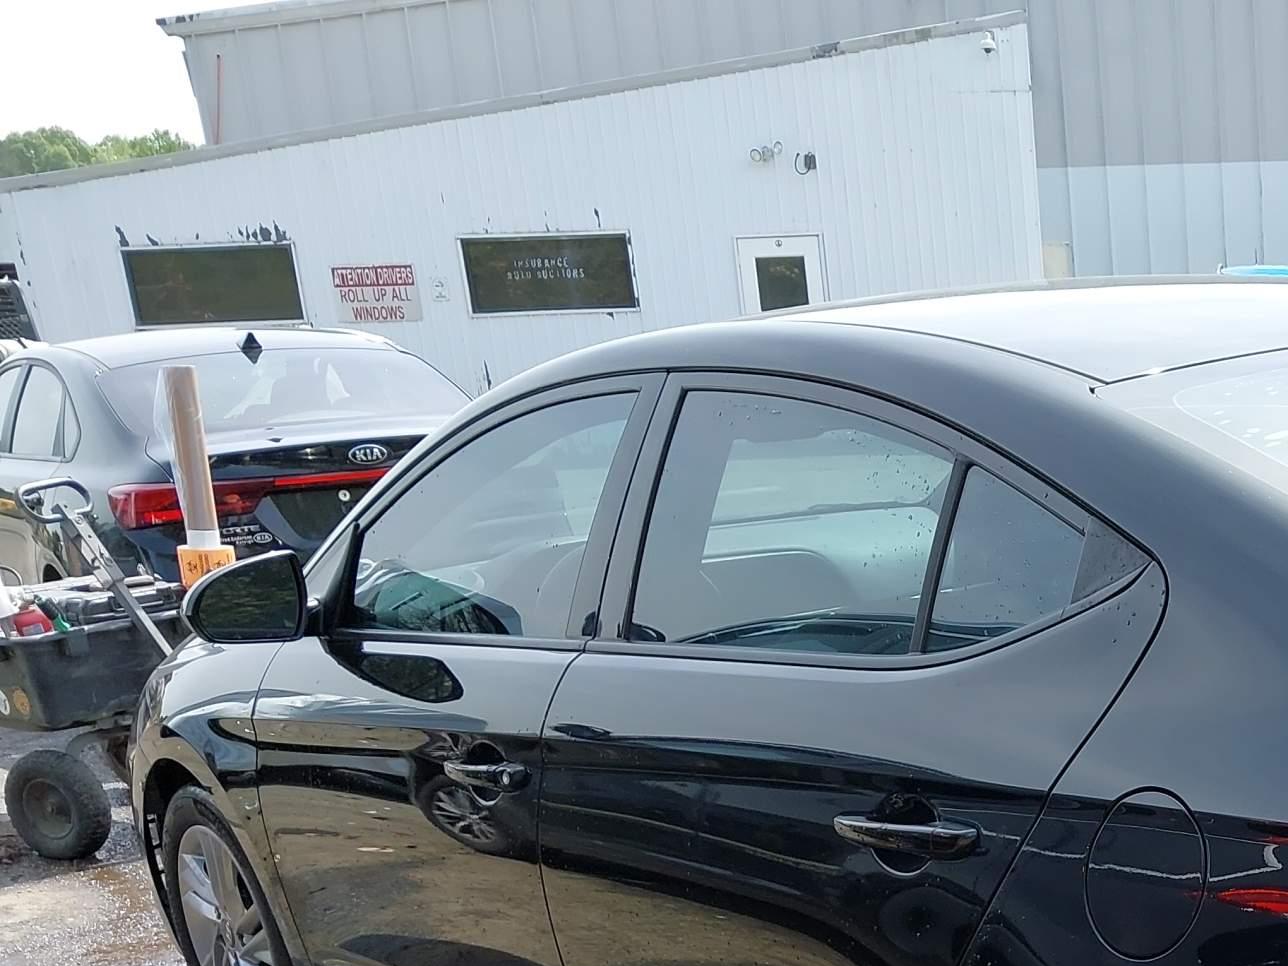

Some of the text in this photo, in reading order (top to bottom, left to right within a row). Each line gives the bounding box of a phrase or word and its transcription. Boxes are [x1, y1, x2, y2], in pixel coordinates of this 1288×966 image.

[334, 266, 413, 286] ATTENTION DRIVERS
[340, 287, 412, 303] ROLL UP ALL
[352, 305, 405, 321] WINDOWS
